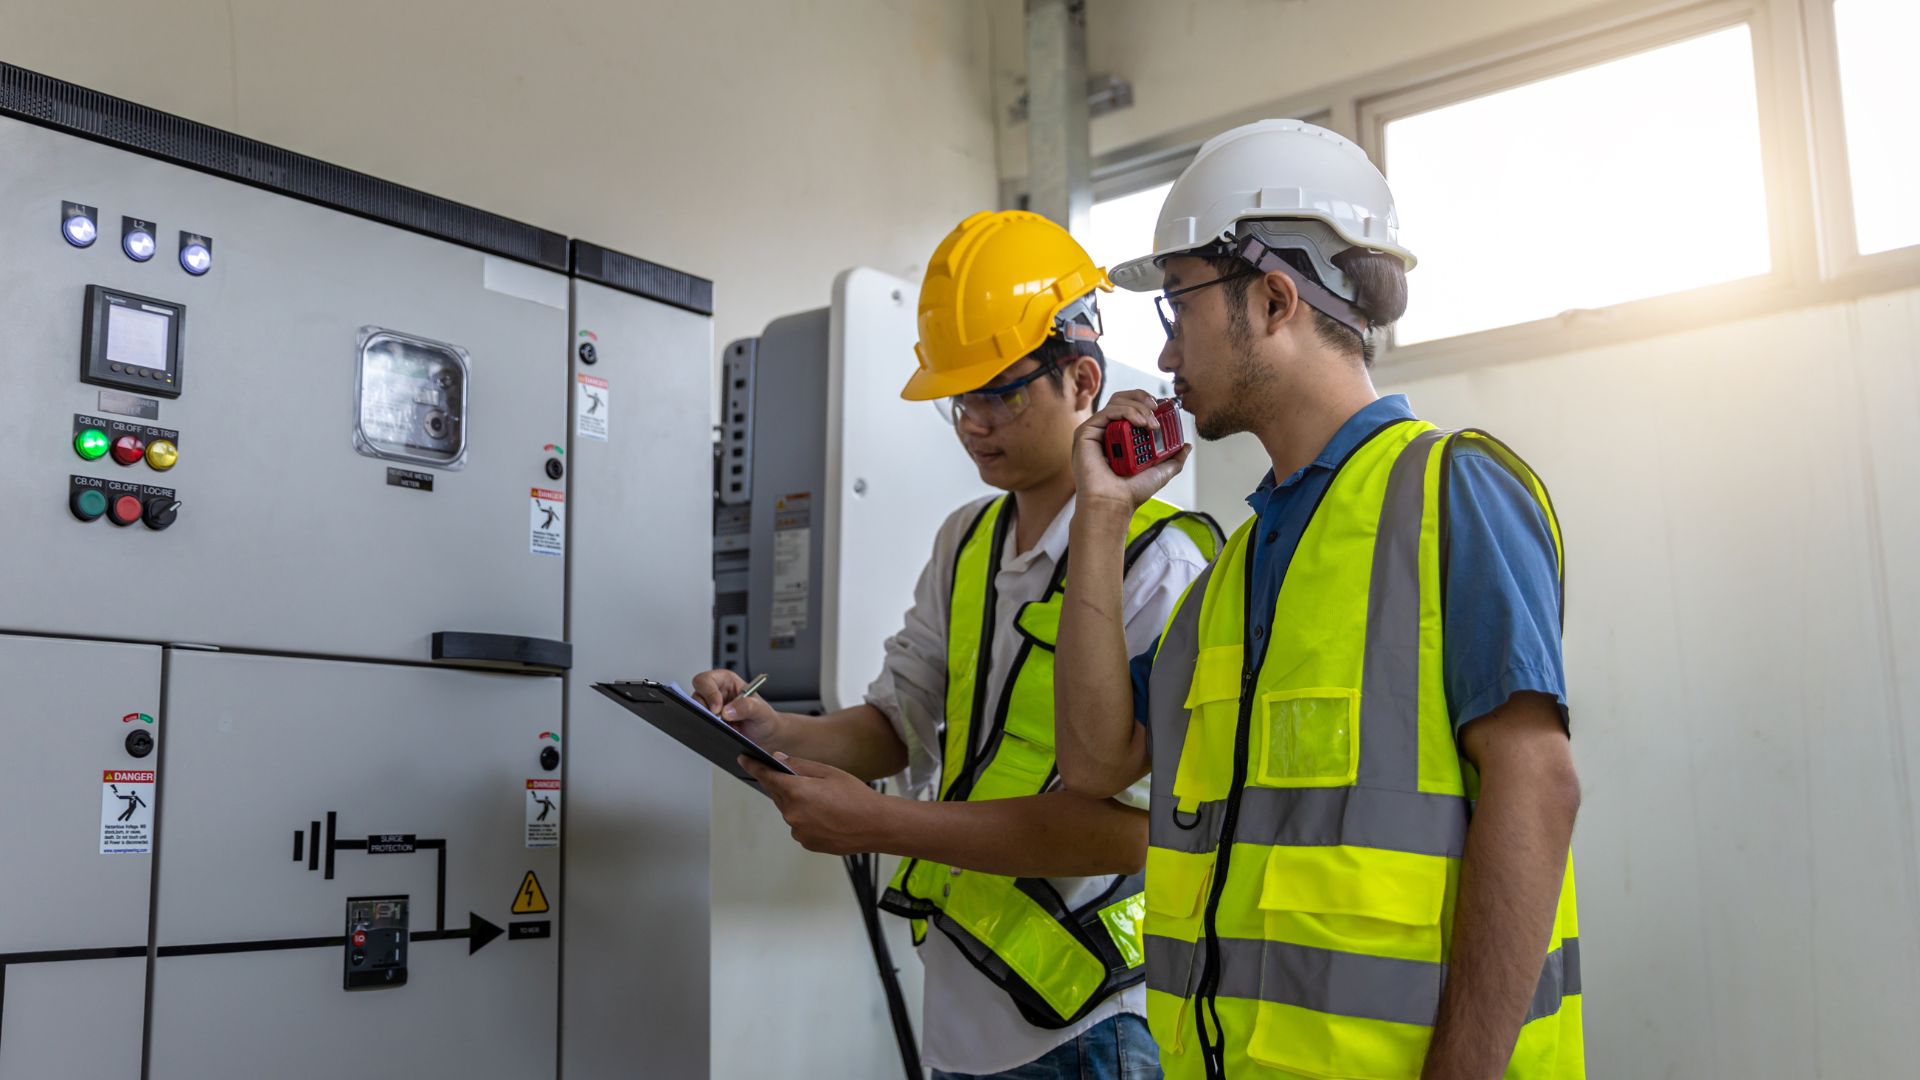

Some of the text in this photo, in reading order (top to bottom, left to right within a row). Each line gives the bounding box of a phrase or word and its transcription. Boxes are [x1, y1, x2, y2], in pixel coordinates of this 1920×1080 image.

[75, 204, 86, 213] L1
[133, 219, 145, 228] L2
[113, 771, 154, 781] DANGER
[370, 843, 414, 853] PROTECTION
